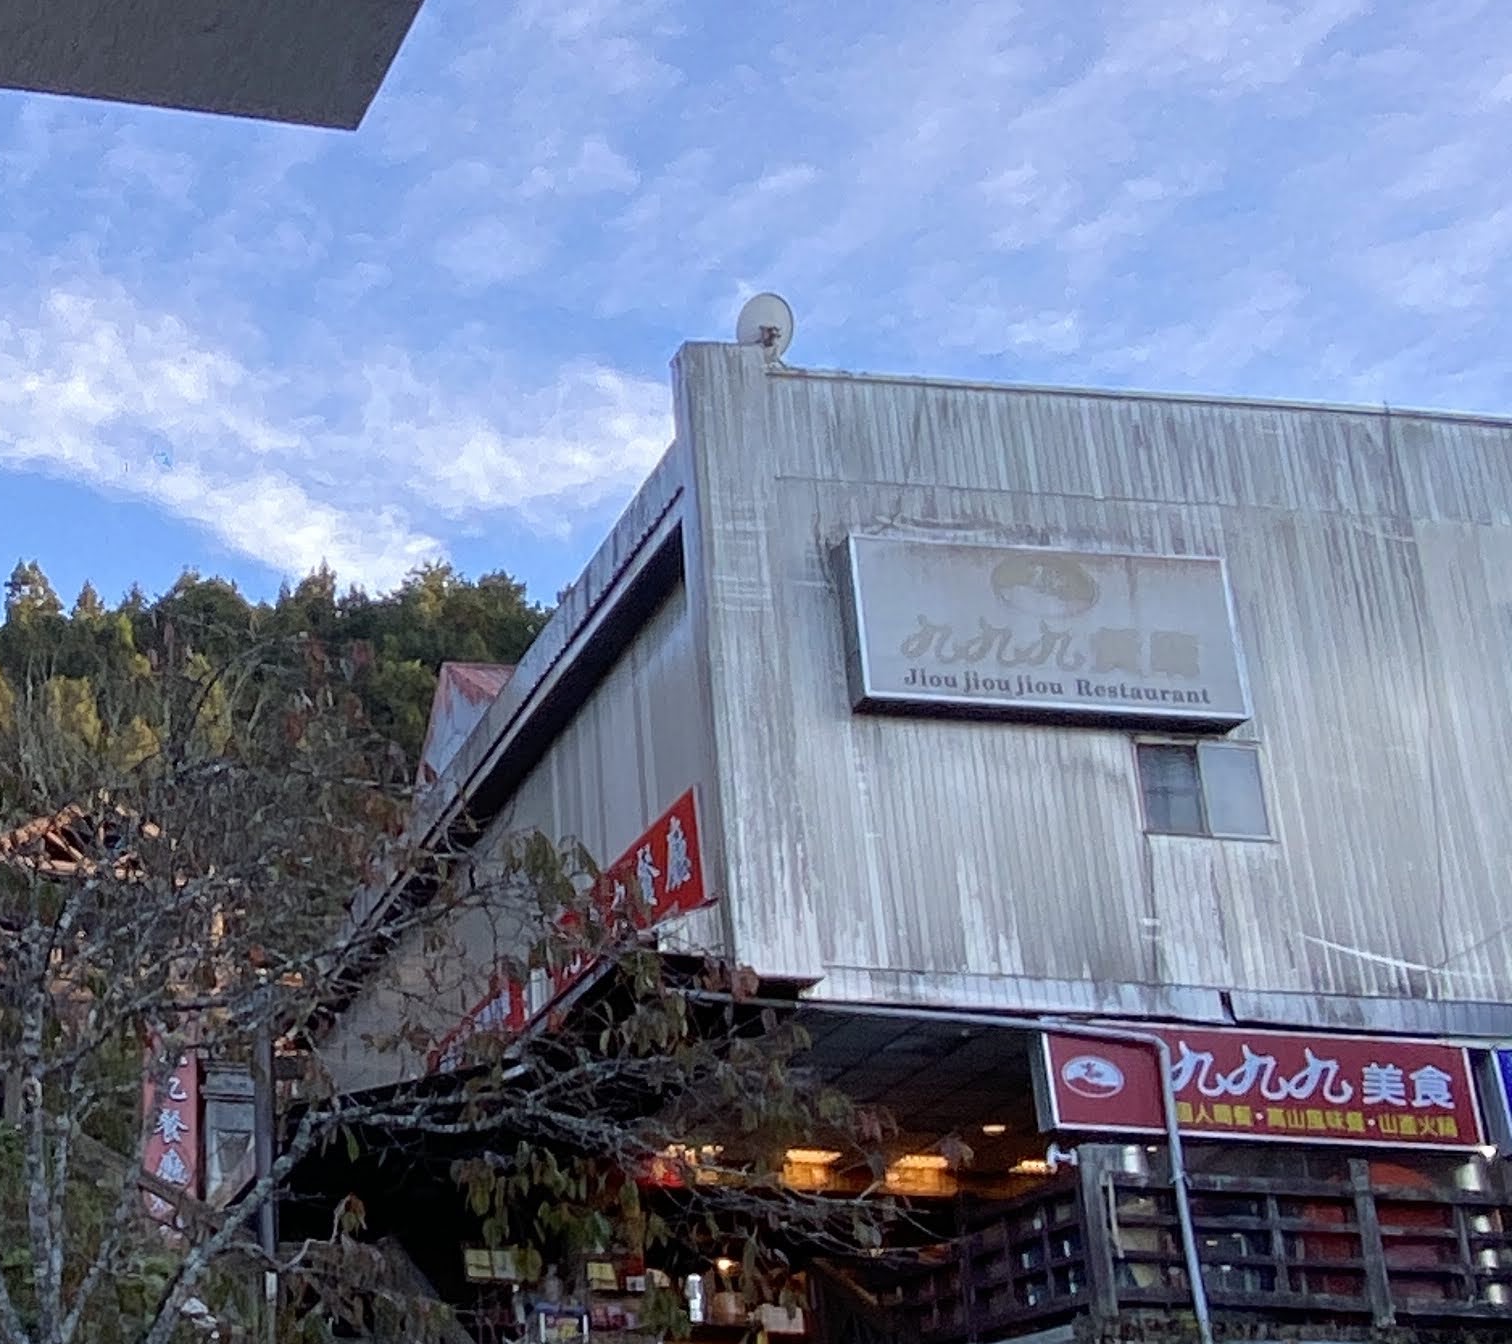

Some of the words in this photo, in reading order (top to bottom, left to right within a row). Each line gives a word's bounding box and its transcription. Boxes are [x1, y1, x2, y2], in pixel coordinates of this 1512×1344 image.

[1075, 678, 1212, 705] Restaurant
[1172, 1041, 1456, 1111] 九九九美食
